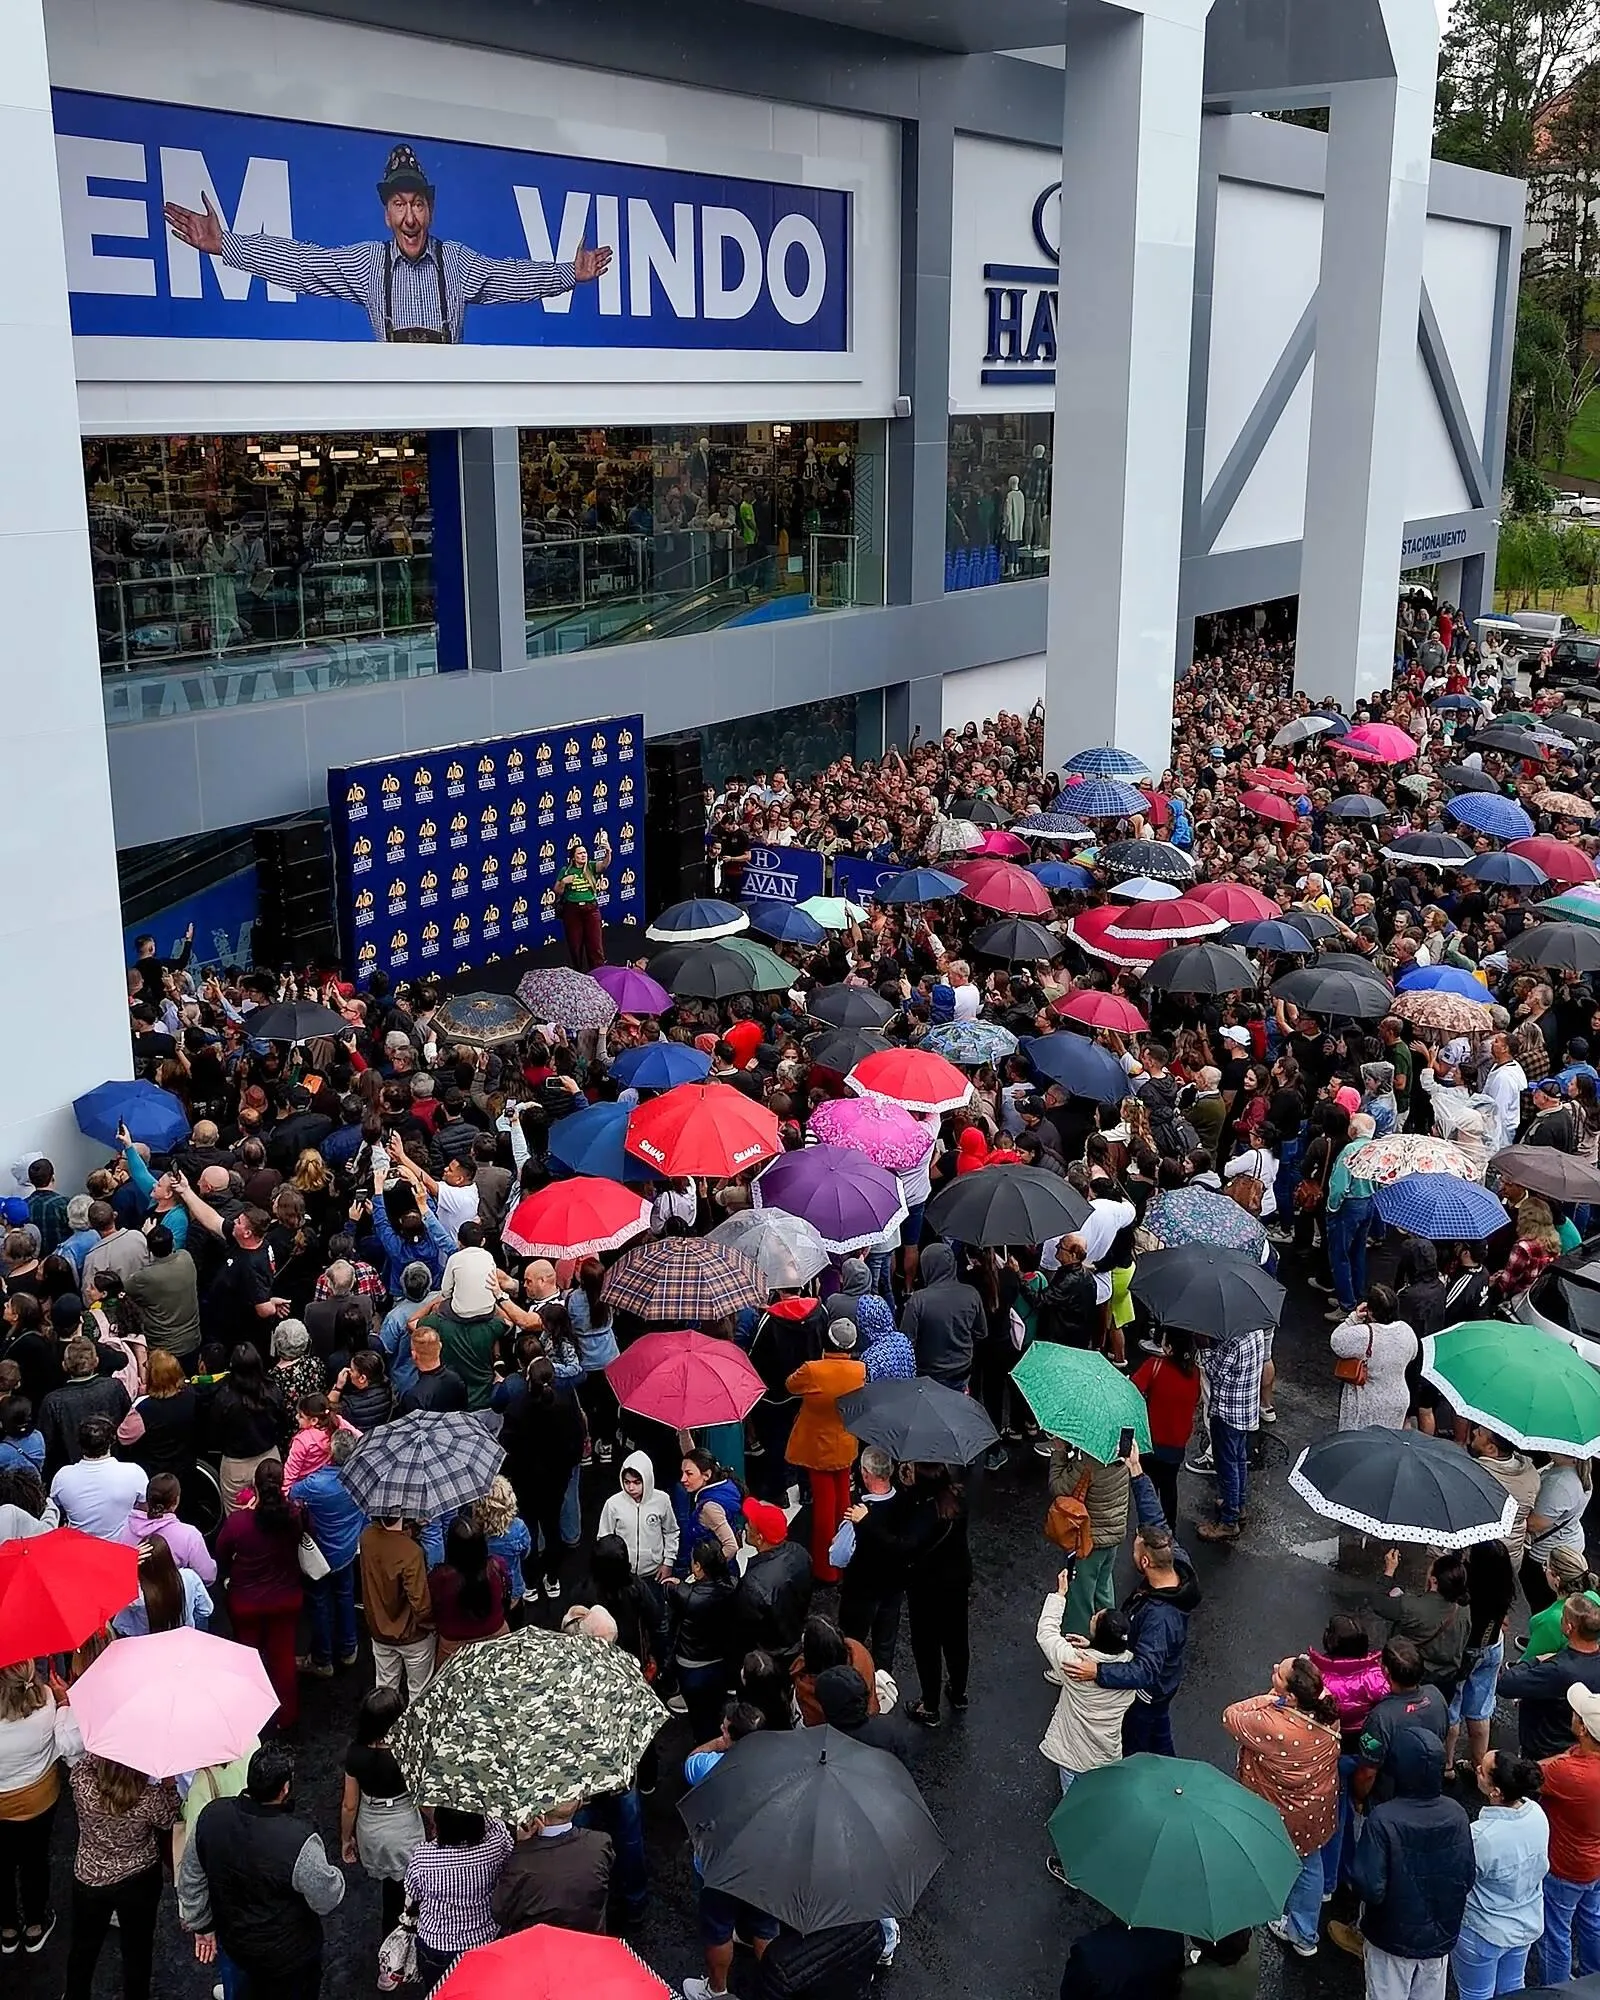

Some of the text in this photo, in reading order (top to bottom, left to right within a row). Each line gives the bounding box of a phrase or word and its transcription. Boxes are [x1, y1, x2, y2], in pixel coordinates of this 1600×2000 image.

[513, 184, 827, 326] VINDO
[983, 287, 1060, 363] HA
[742, 872, 798, 898] AVAN
[755, 851, 769, 868] H
